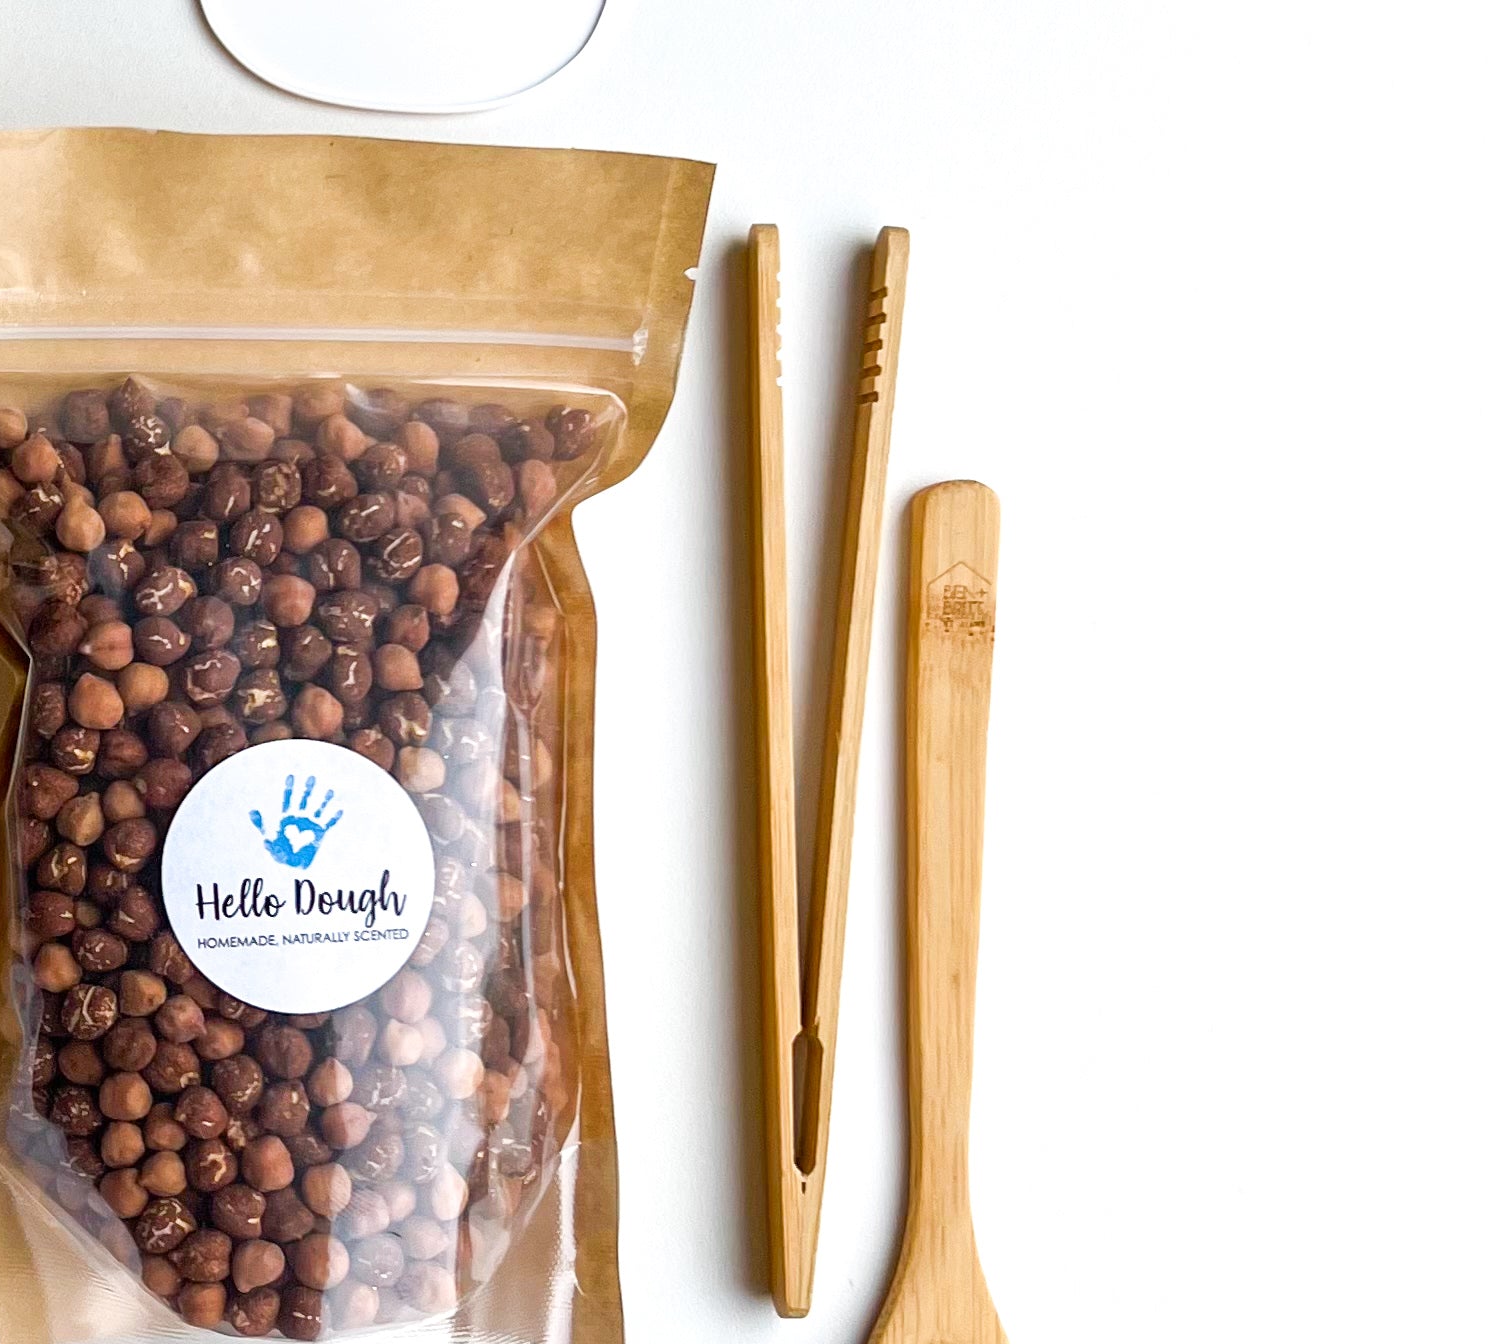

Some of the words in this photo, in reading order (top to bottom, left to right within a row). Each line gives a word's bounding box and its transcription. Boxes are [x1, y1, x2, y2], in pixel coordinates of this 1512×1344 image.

[195, 878, 286, 921] Hello
[294, 869, 407, 928] Dough
[282, 931, 349, 945] NATURALLY
[354, 928, 409, 942] SCENTED
